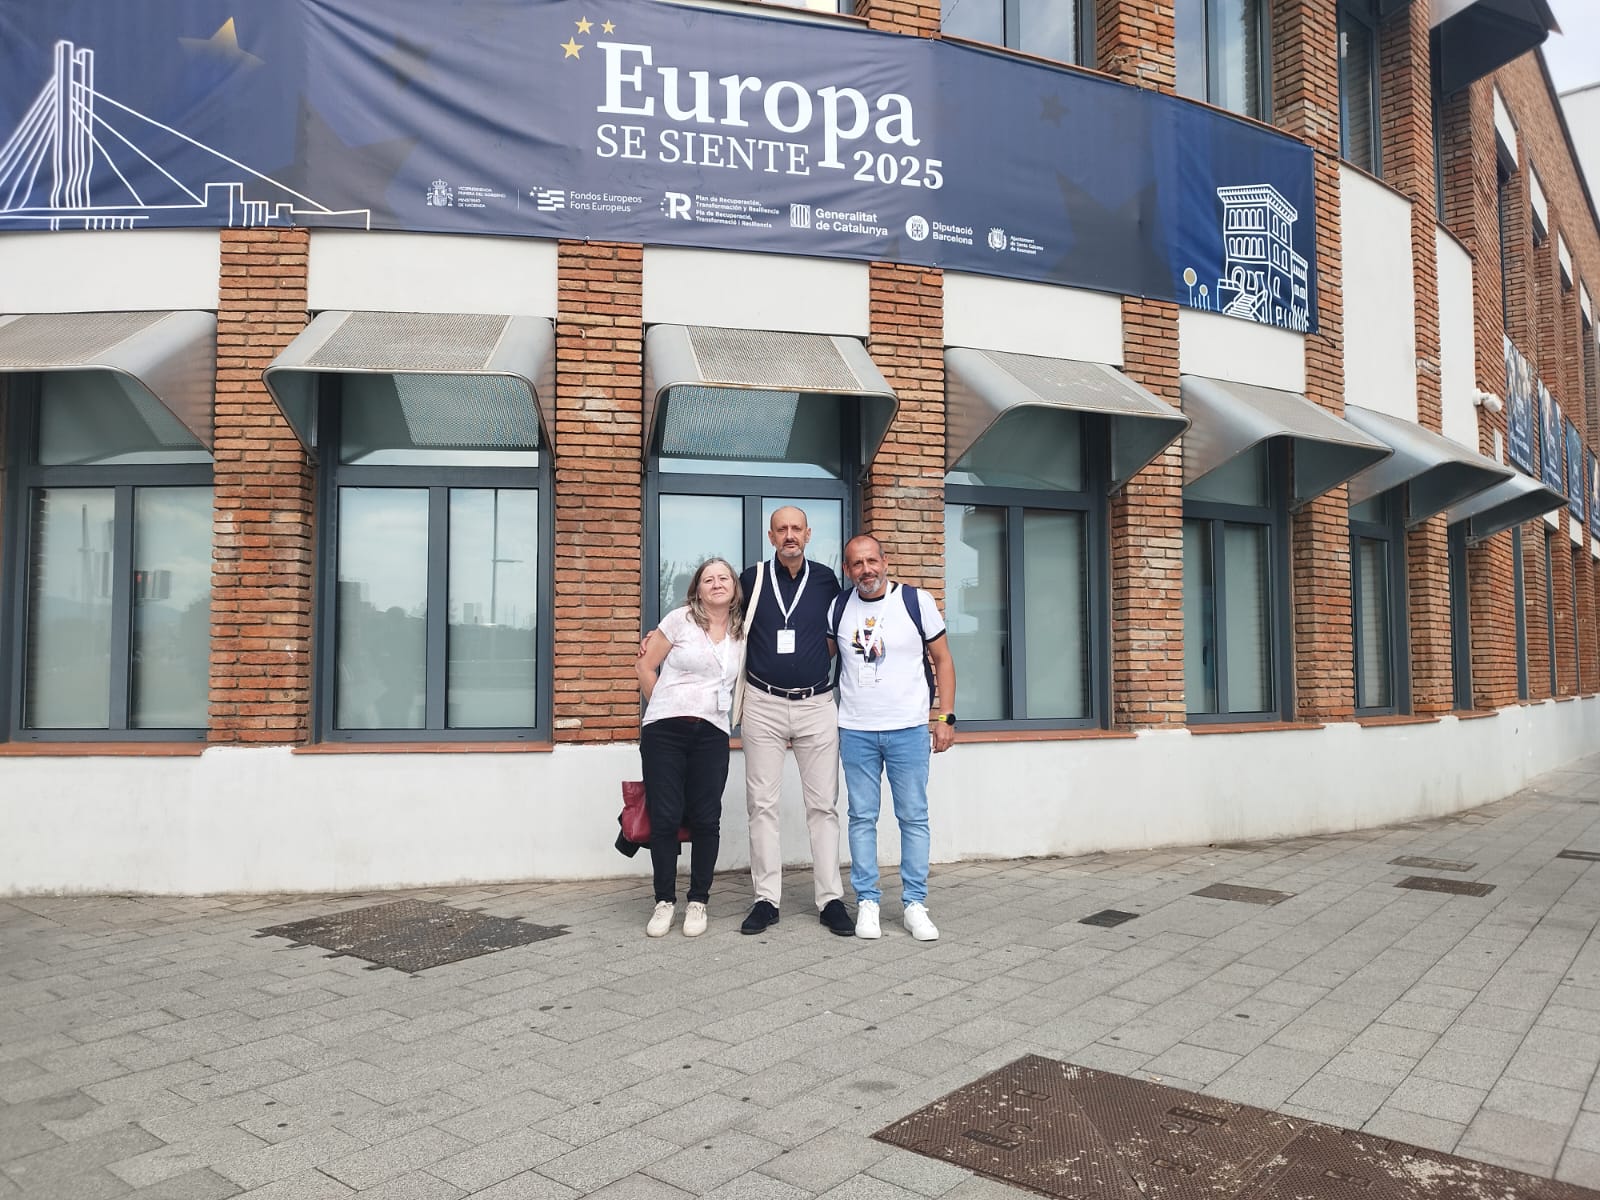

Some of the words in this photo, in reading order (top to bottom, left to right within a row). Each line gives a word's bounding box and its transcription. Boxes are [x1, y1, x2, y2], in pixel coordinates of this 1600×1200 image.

[596, 41, 921, 169] Europa
[596, 123, 647, 160] SE
[658, 129, 811, 176] SIENTE
[853, 150, 944, 190] 2025
[570, 191, 601, 201] Fondos
[603, 193, 642, 204] Europeos
[695, 194, 709, 202] Plan
[570, 201, 591, 210] Fons
[592, 202, 632, 214] Europeus
[815, 208, 878, 223] Generalitat
[815, 220, 831, 231] de
[833, 221, 889, 237] Catalunya
[932, 221, 973, 235] Diputació
[932, 232, 973, 246] Barcelona
